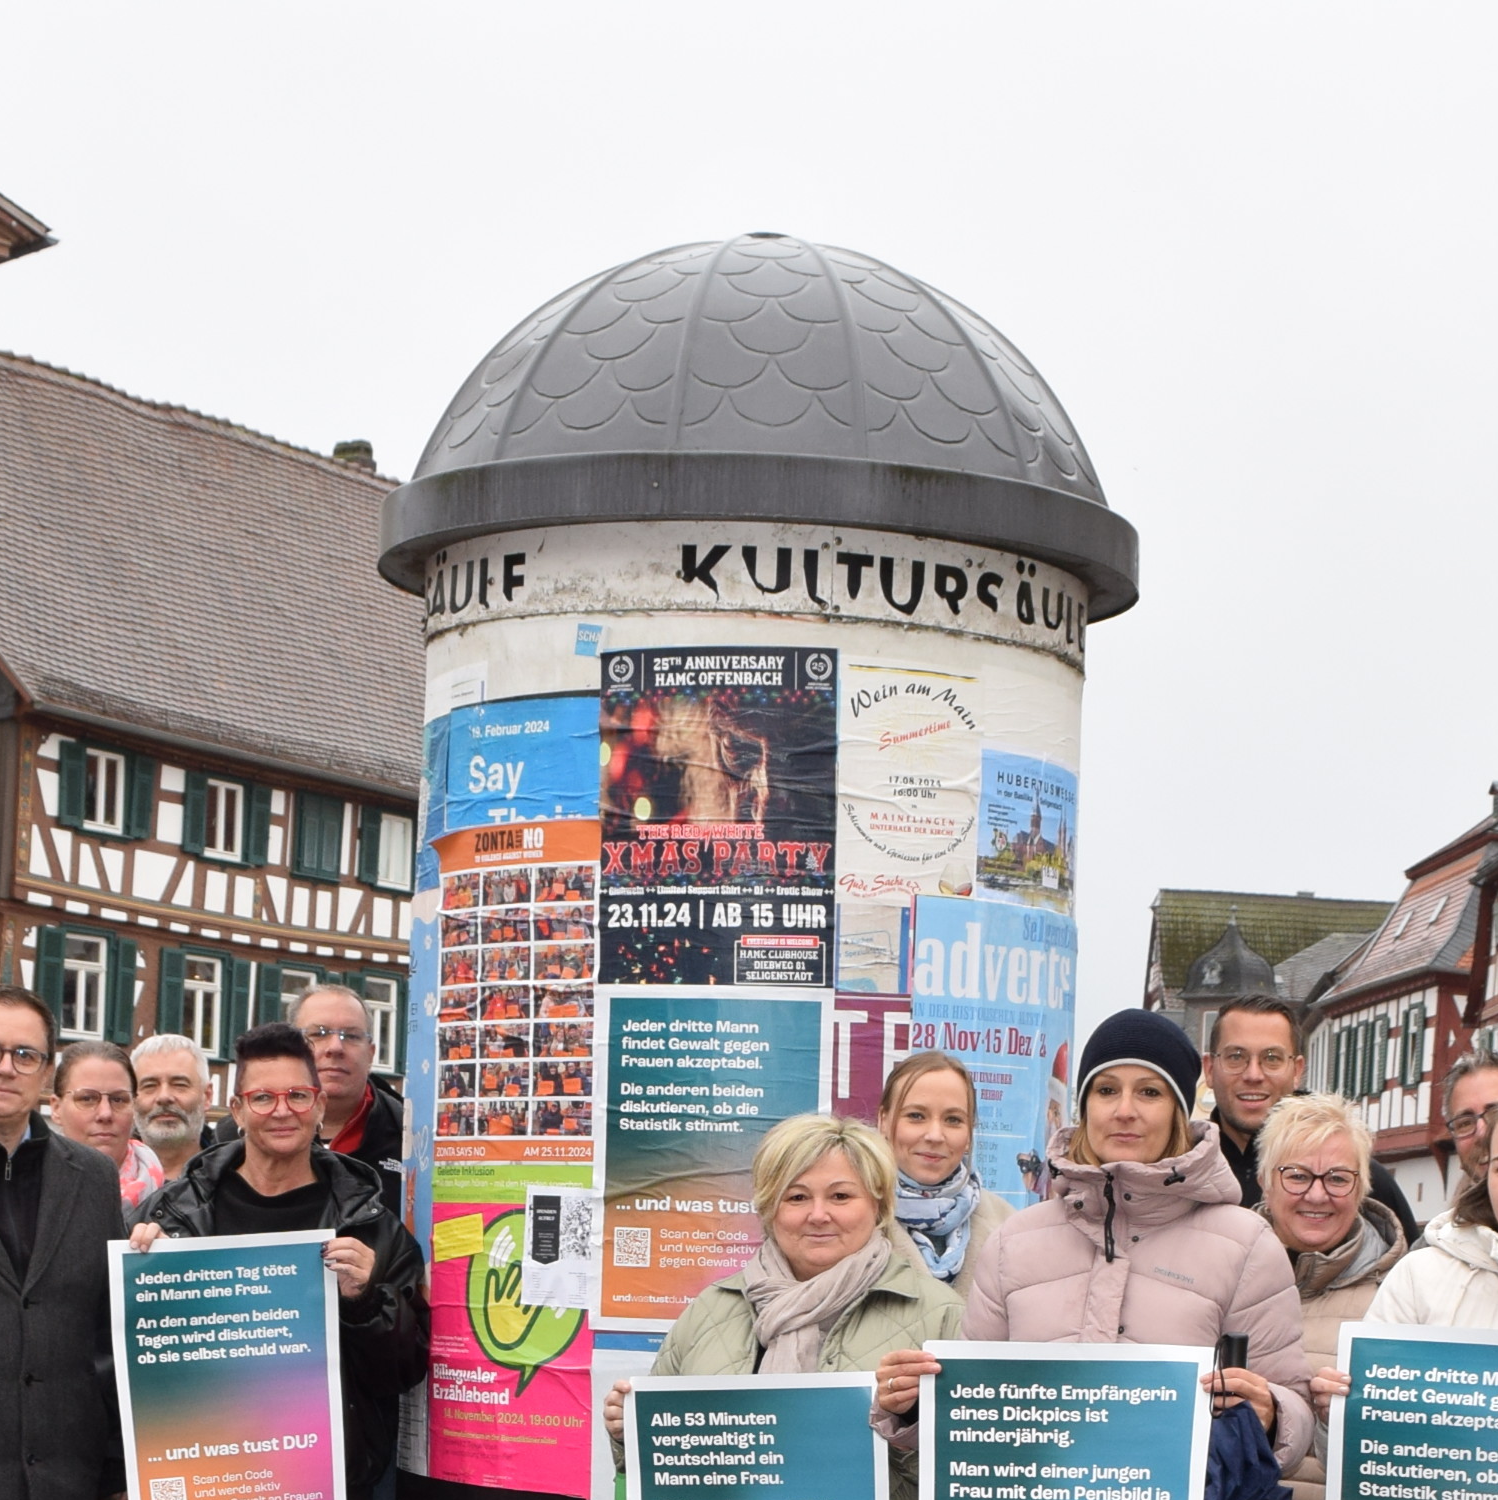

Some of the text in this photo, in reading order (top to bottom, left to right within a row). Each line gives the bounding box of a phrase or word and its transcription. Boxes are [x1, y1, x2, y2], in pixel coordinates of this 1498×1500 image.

[653, 656, 785, 671] 25TH ANNIVERSARY
[655, 671, 782, 686] HAMC OFFENBACH
[851, 683, 976, 730] Wein am Main
[485, 723, 521, 737] Februar
[525, 720, 549, 733] 2024
[878, 720, 950, 751] Summertime
[468, 755, 524, 800] Say
[921, 789, 937, 799] Uhr
[870, 812, 955, 826] MAINFLINGEN
[475, 829, 514, 852] ZONTA
[523, 827, 544, 849] NO
[636, 824, 764, 840] THE RED WHITE
[603, 842, 831, 875] XMAS PARTY
[688, 886, 719, 897] Support
[722, 886, 740, 895] Shirt
[754, 886, 763, 896] DJ
[777, 886, 799, 896] Erotic
[801, 886, 823, 896] Show
[839, 874, 868, 892] Gude
[871, 874, 903, 891] Sache
[607, 903, 826, 928] 23.11.24 AB 15 UHR
[739, 950, 819, 960] HAMC CLUBHOUSE
[754, 961, 794, 970] DIEBWEG
[745, 971, 814, 981] SELIGENSTADT
[623, 1019, 758, 1033] Jeder dritte Mann
[436, 1147, 485, 1157] ZONTA SAYS NO
[523, 1147, 591, 1157] AM 25.11.2024
[462, 1167, 494, 1175] Inklusion
[135, 1264, 297, 1284] Jeden dritten Tag tötet
[136, 1284, 271, 1302] ein Mann eine Frau.
[433, 1363, 497, 1384] Bilingualer
[1365, 1364, 1421, 1380] Jeder
[1425, 1368, 1478, 1384] dritte
[433, 1383, 509, 1405] Erzählabend
[950, 1384, 1176, 1404] Jede fünfte Empfängerin
[1363, 1384, 1418, 1402] findet
[1422, 1389, 1486, 1406] Gewalt
[444, 1408, 453, 1418] 14.
[454, 1409, 494, 1422] November
[530, 1415, 560, 1427] 19:00
[563, 1416, 585, 1428] Uhr
[651, 1412, 776, 1426] Alle 53 Minuten
[1362, 1406, 1427, 1424] Frauen
[652, 1432, 774, 1449] vergewaltigt in
[653, 1451, 783, 1465] Deutschland ein
[655, 1472, 783, 1485] Mann eine Frau.
